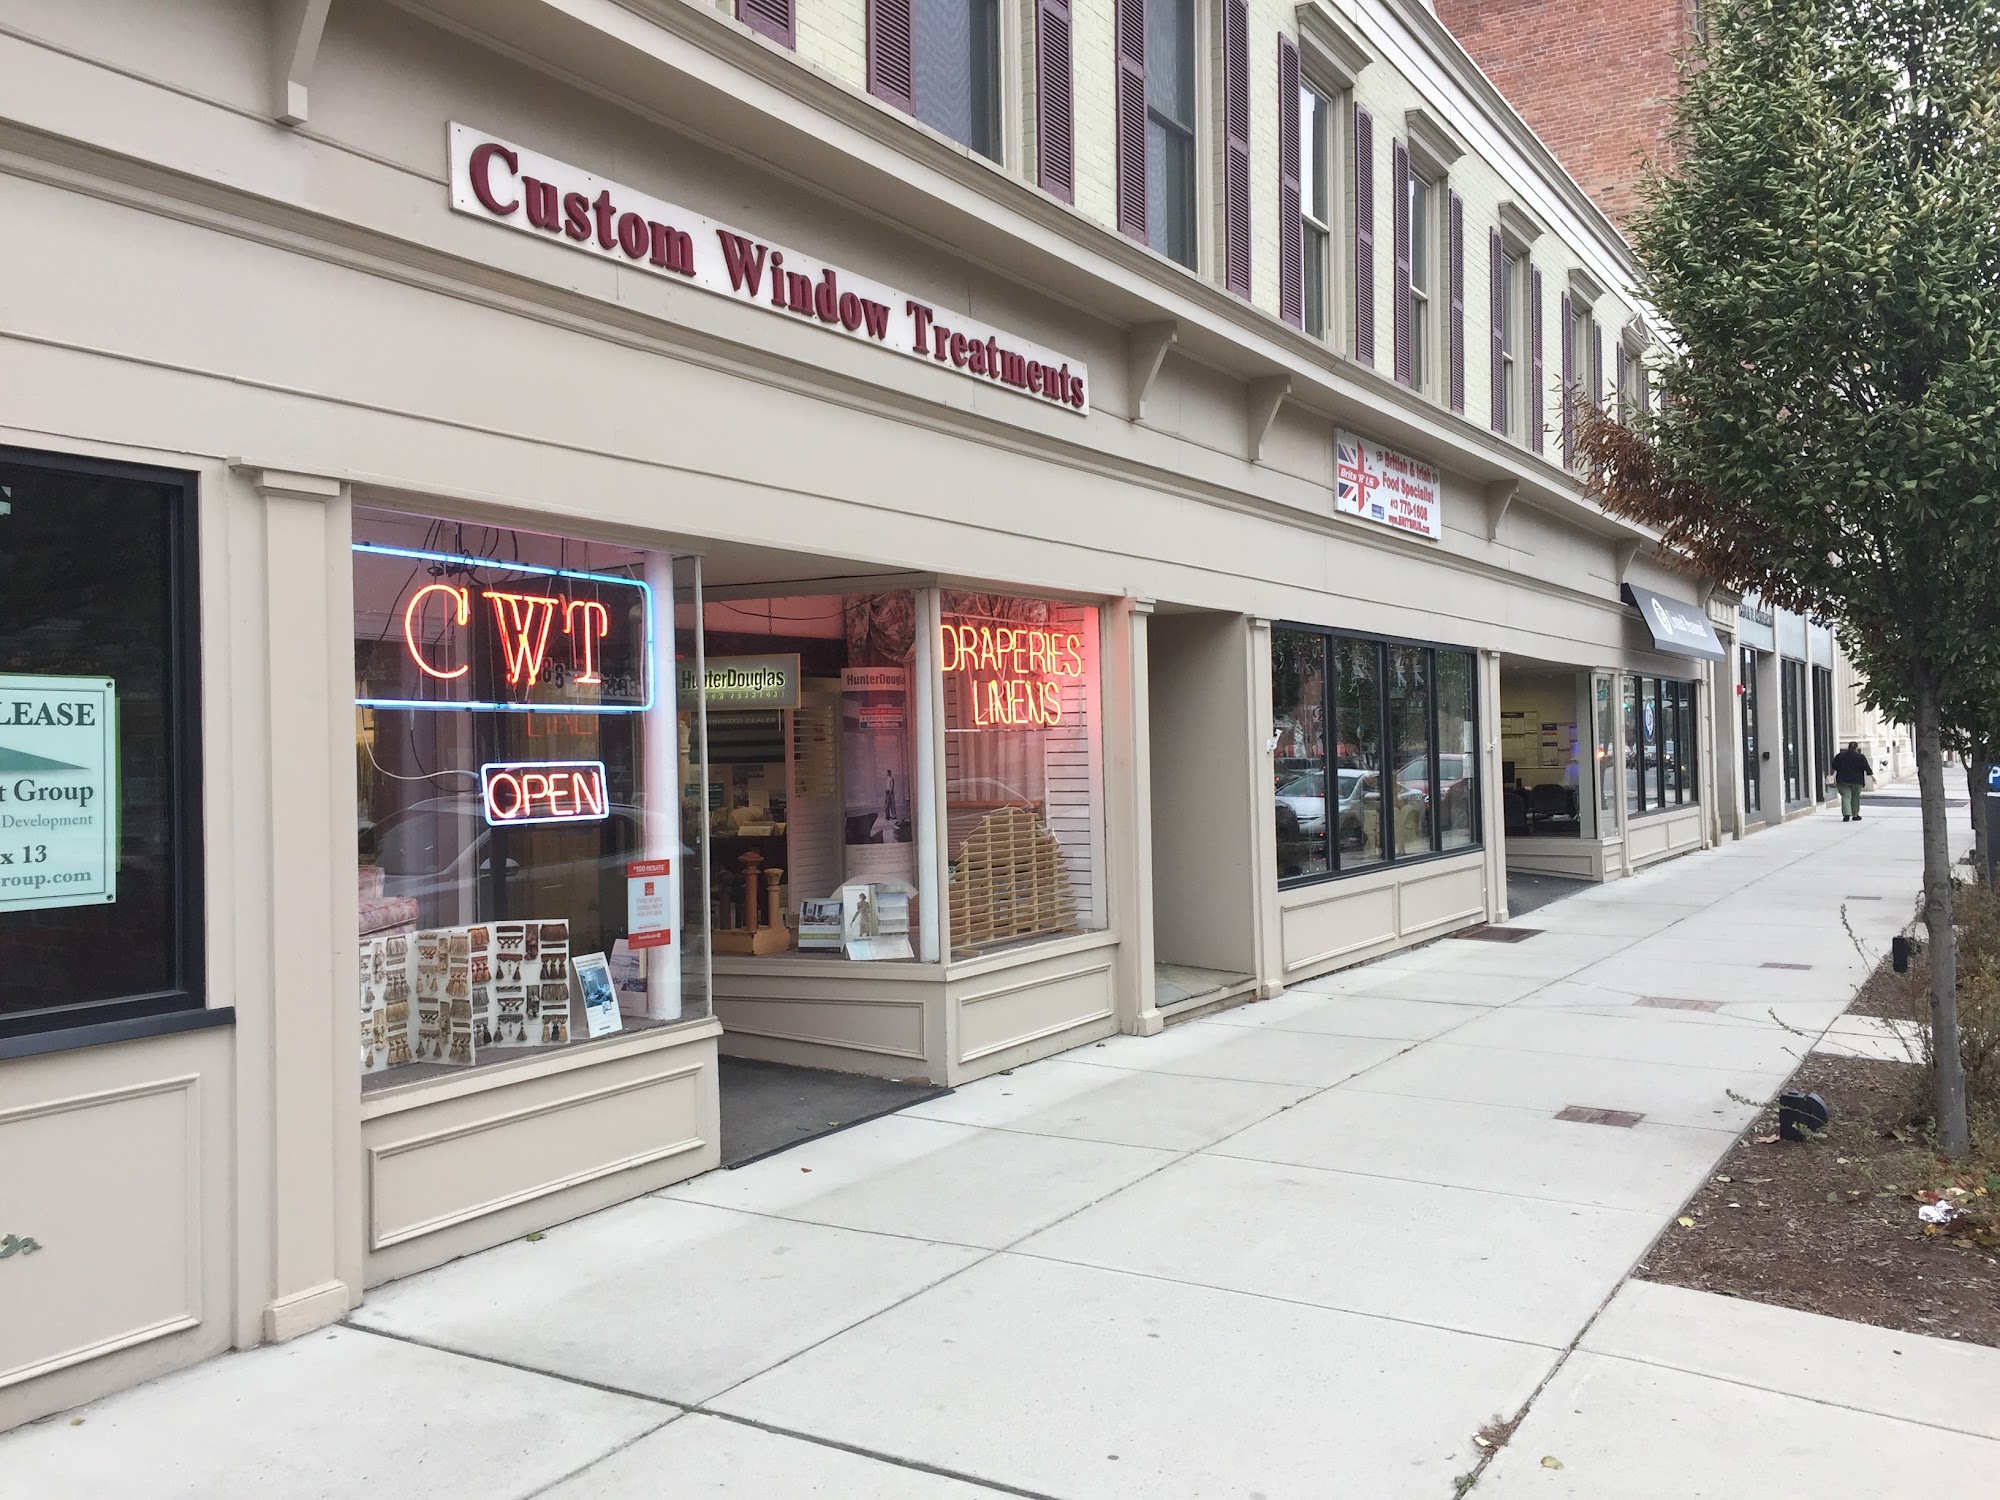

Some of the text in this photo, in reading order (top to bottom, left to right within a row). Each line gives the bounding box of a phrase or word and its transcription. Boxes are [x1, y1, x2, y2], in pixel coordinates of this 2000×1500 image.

[469, 142, 1085, 408] Custom Window Treatments
[1340, 467, 1357, 481] Brits
[1384, 451, 1408, 474] British
[1409, 461, 1415, 477] &
[1382, 471, 1434, 504] Food Specialist
[404, 584, 611, 686] CWT
[939, 624, 1082, 677] DRAPERIES
[681, 667, 785, 691] HunterDouglas
[972, 680, 1062, 726] LINENS
[13, 778, 94, 808] Group
[488, 772, 603, 819] OPEN
[2, 813, 93, 830] Development
[22, 844, 48, 864] 13
